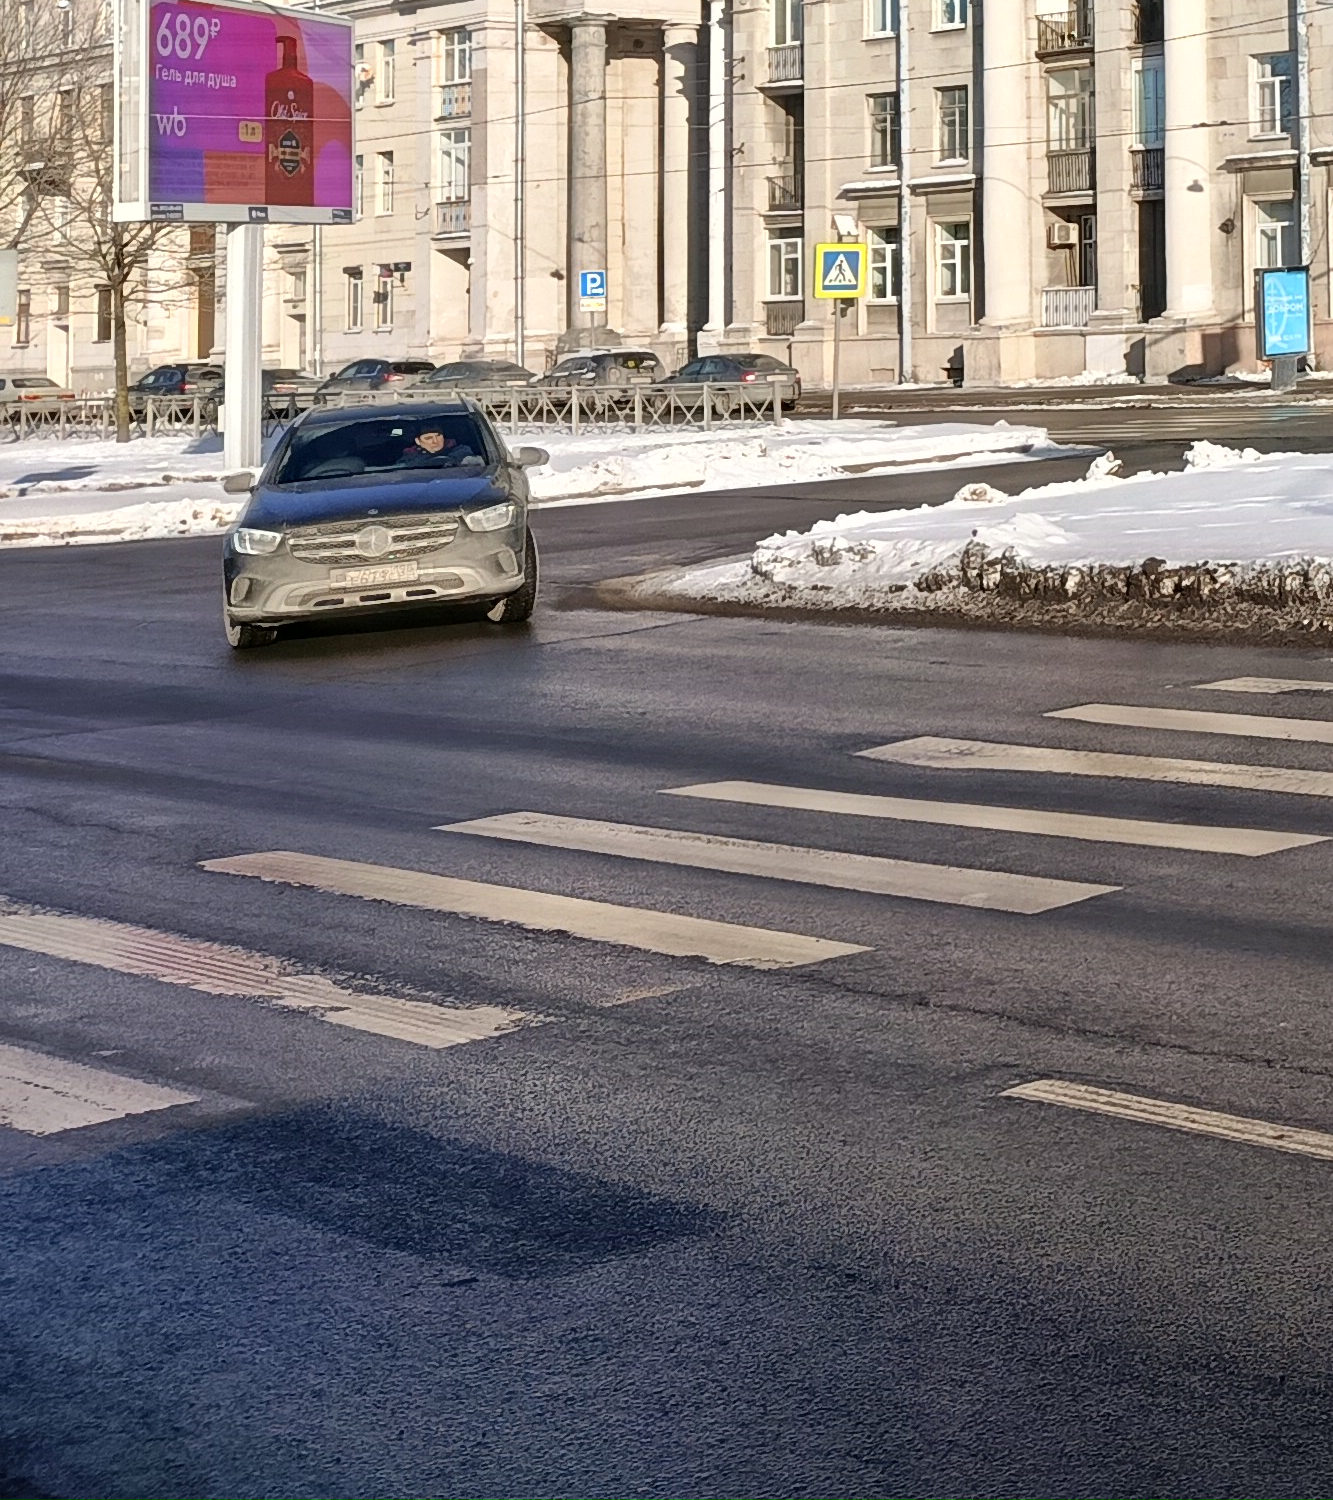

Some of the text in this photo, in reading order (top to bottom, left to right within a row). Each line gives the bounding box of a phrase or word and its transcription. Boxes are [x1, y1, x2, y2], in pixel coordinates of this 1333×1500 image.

[155, 64, 237, 89] Гель для душа
[156, 106, 186, 137] wb
